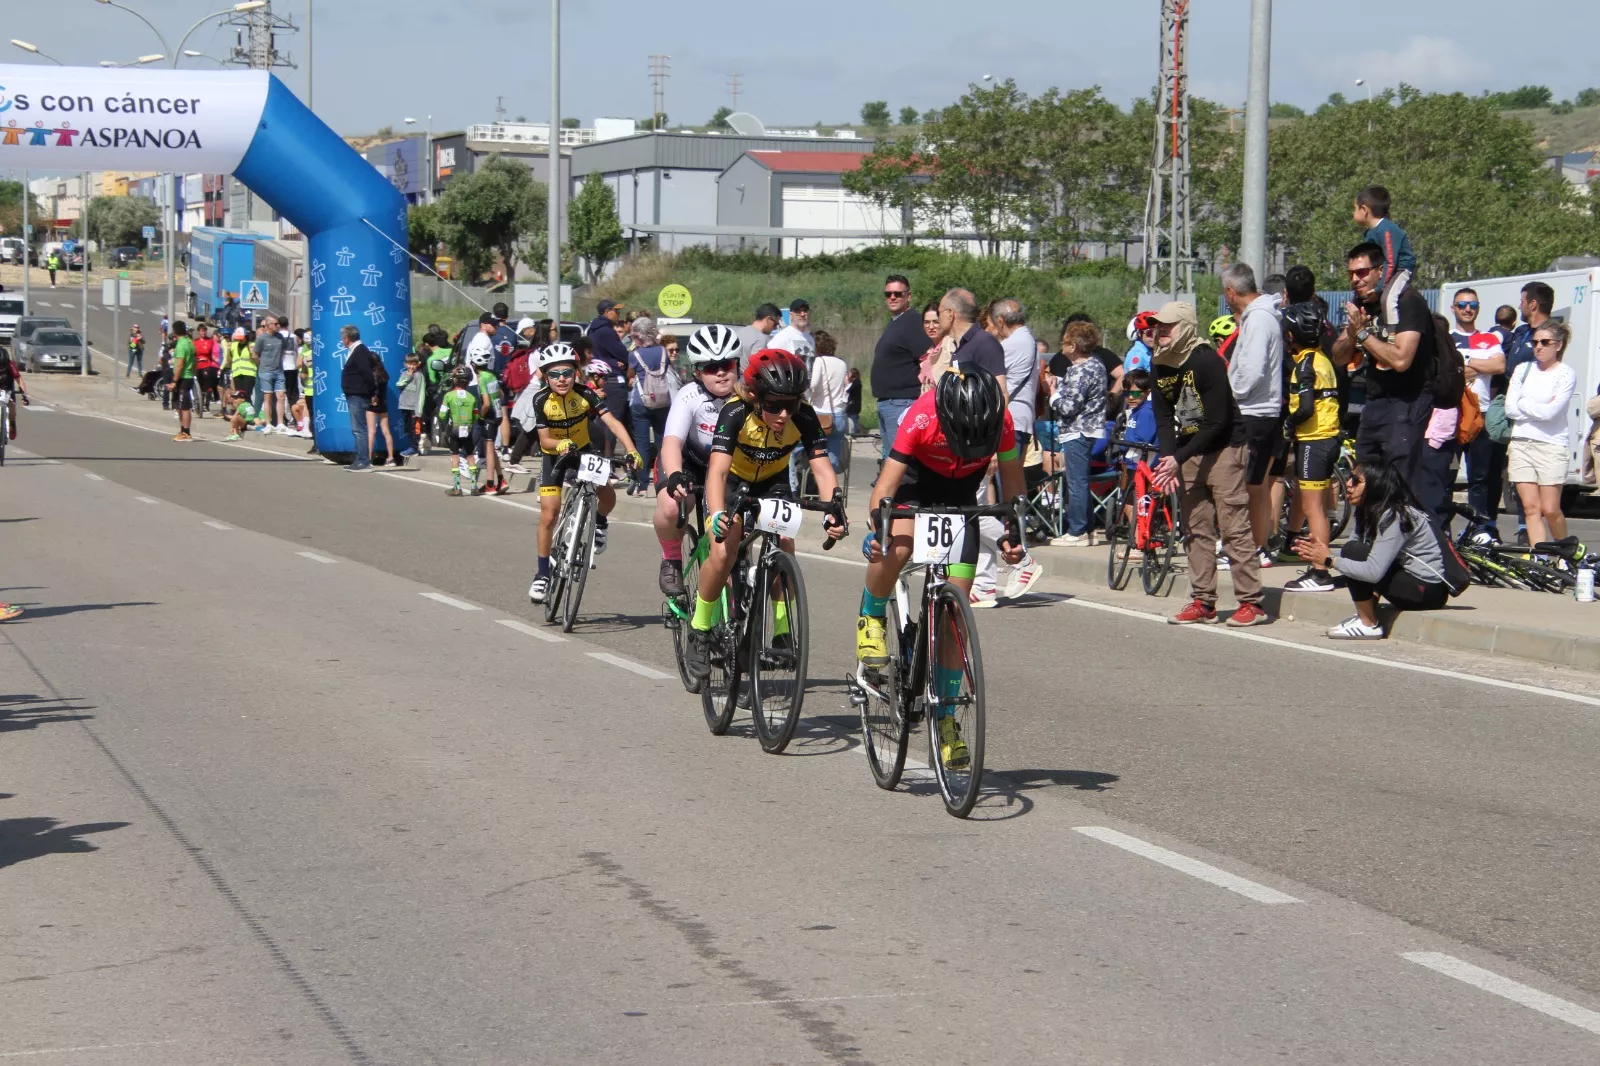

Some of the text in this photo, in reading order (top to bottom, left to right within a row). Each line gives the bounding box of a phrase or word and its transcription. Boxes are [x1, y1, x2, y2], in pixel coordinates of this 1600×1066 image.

[41, 95, 94, 112] con
[104, 92, 201, 114] cáncer
[80, 127, 202, 149] ASPANOA
[663, 299, 685, 307] STOP
[587, 456, 604, 474] 62
[770, 499, 792, 523] 75
[927, 516, 952, 547] 56
